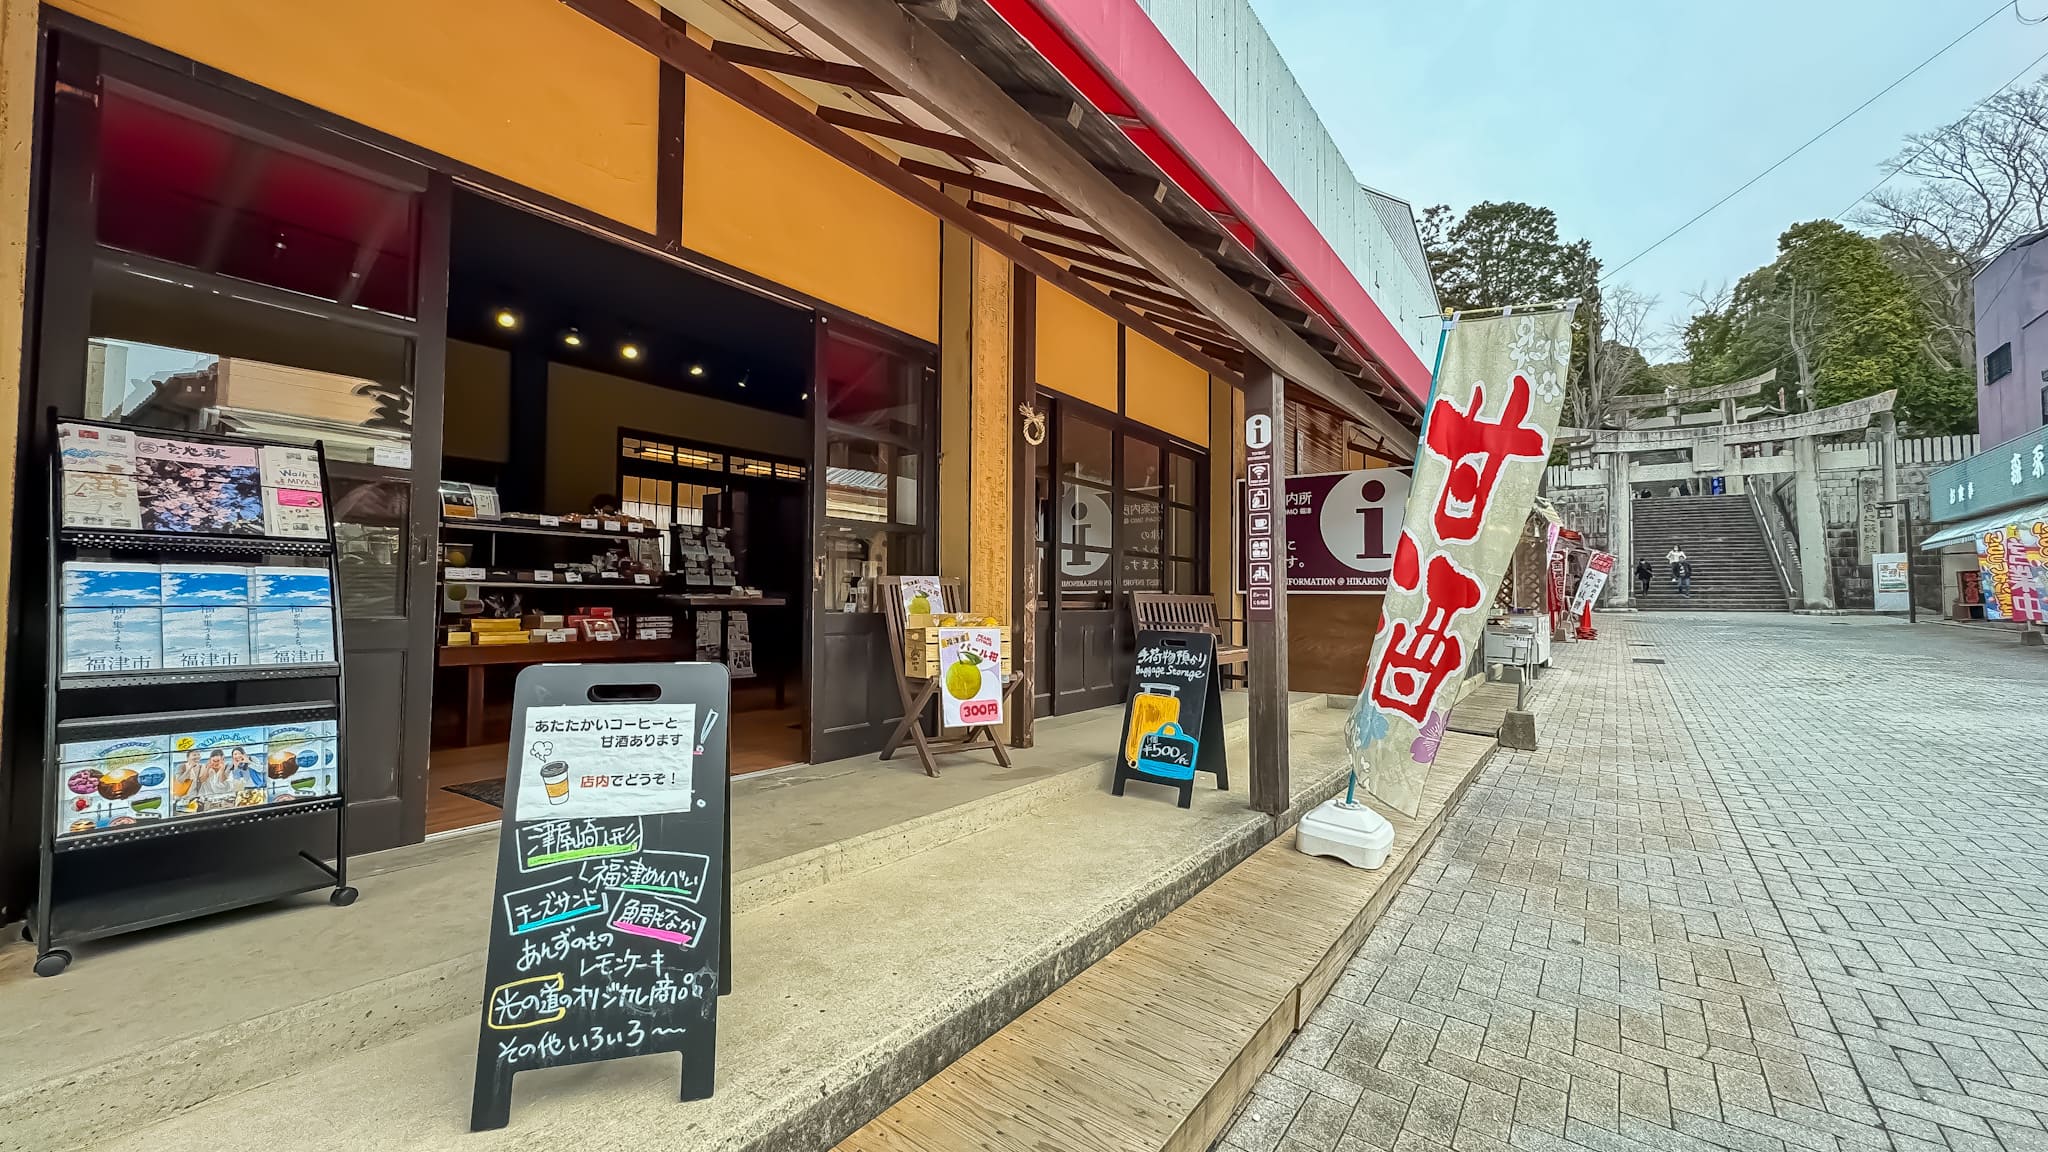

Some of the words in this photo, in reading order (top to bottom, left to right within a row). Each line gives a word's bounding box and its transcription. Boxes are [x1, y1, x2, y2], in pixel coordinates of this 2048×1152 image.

[1361, 375, 1543, 722] 甘酒
[84, 655, 152, 671] 福津市
[179, 651, 239, 667] 福津市
[272, 650, 325, 663] 福津市
[1166, 665, 1206, 682] Storage
[963, 703, 998, 718] 300円
[535, 717, 678, 733] あたたかいコーヒーと
[600, 733, 684, 748] 甘酒あります
[588, 857, 698, 889] 福津めんべい
[515, 888, 599, 924] チーズサンド
[618, 899, 696, 934] 鯛もなか
[581, 949, 665, 977] レモンケーキ
